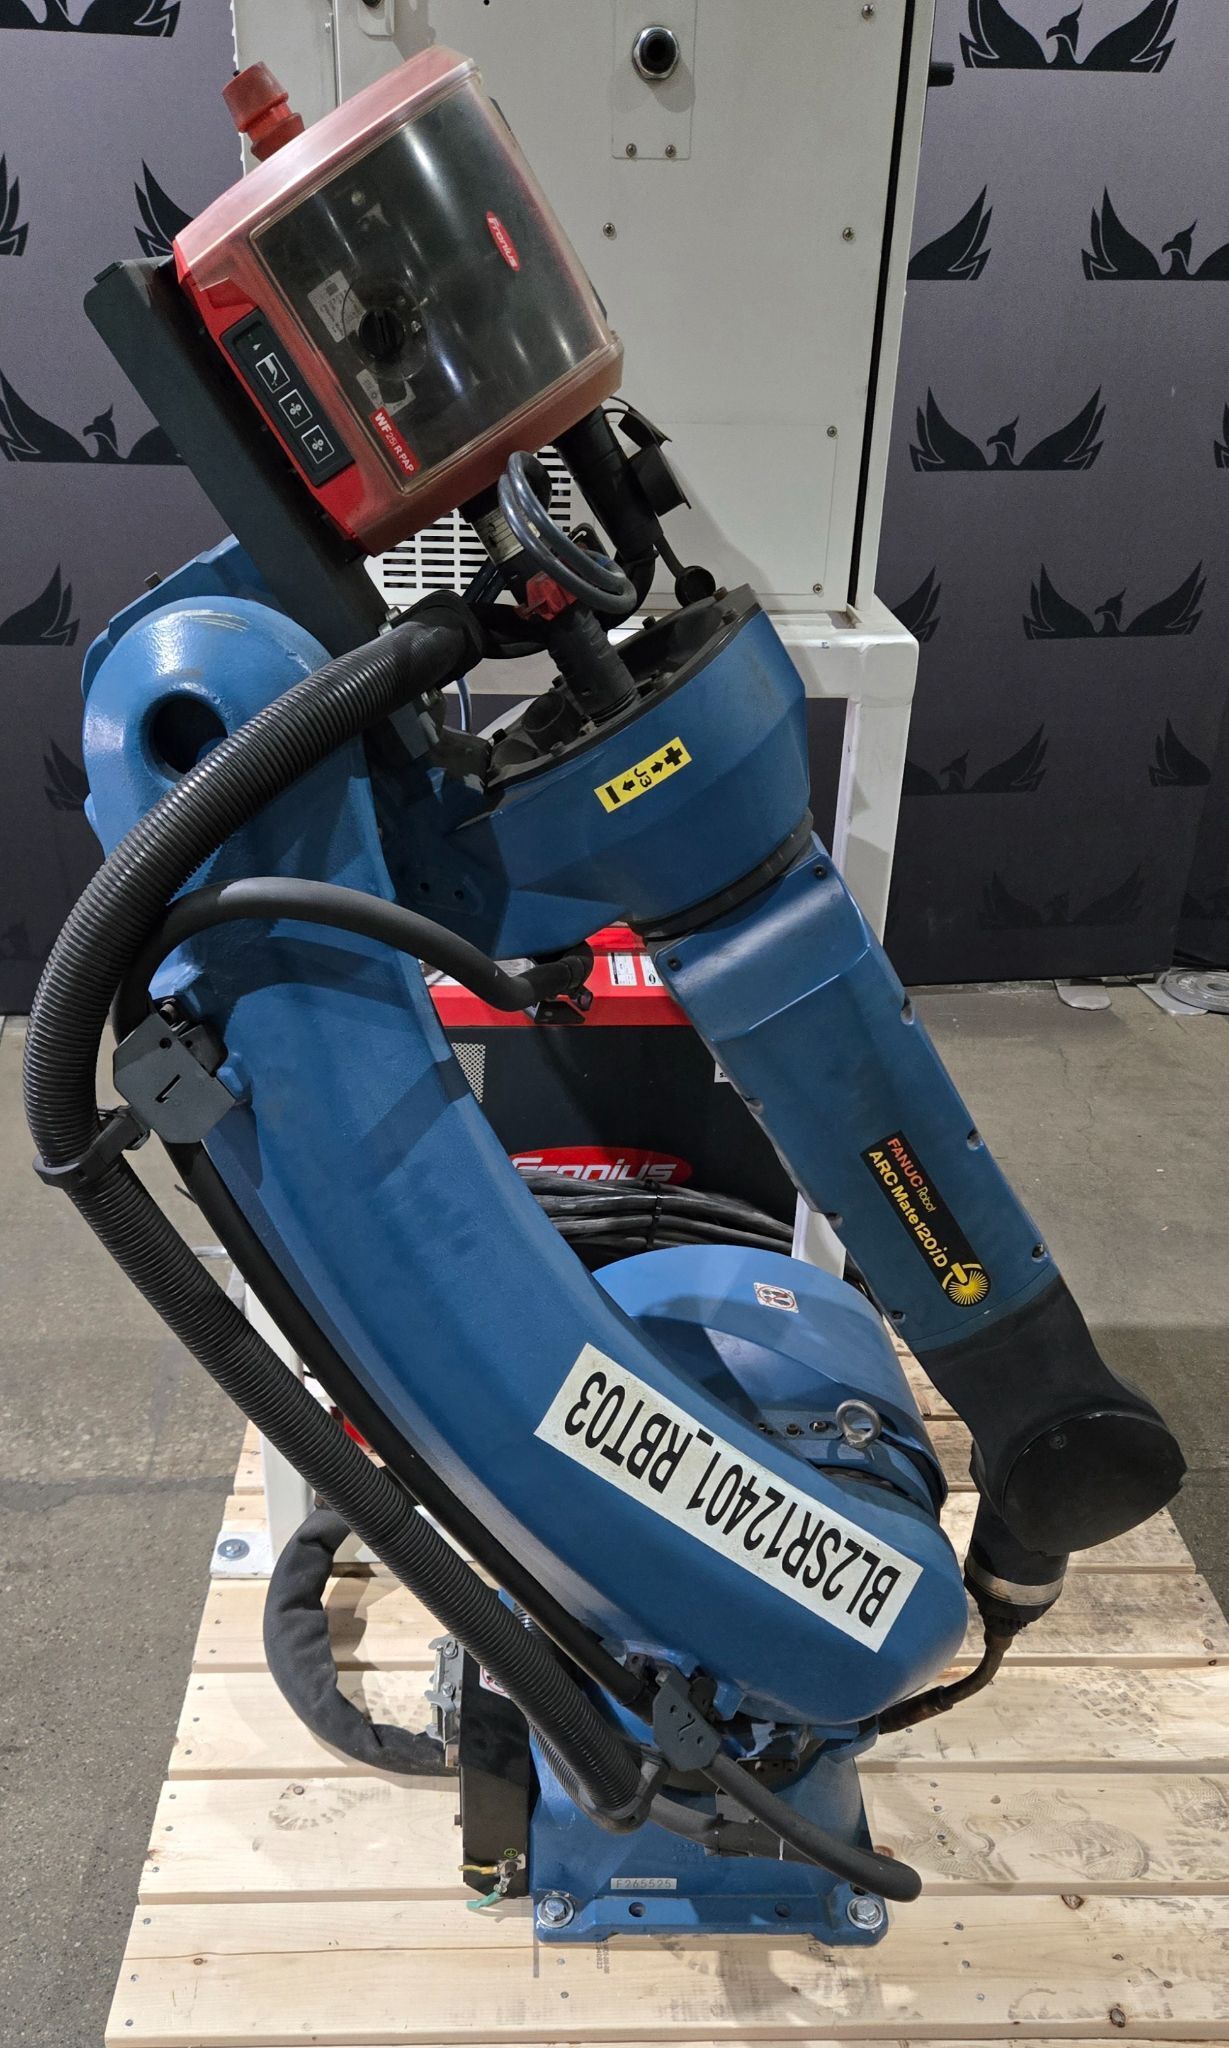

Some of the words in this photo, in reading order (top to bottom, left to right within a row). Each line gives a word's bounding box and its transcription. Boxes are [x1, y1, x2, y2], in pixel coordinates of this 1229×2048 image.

[487, 217, 518, 267] Fronius
[375, 412, 392, 433] WF
[394, 445, 403, 455] R
[399, 453, 415, 472] PAP
[633, 767, 653, 788] J3
[868, 1151, 899, 1187] ARC
[887, 1137, 924, 1188] FANUC
[916, 1186, 937, 1213] Robot
[564, 1371, 902, 1628] BL2SR12401_RBT03
[616, 1879, 672, 1888] F265525
